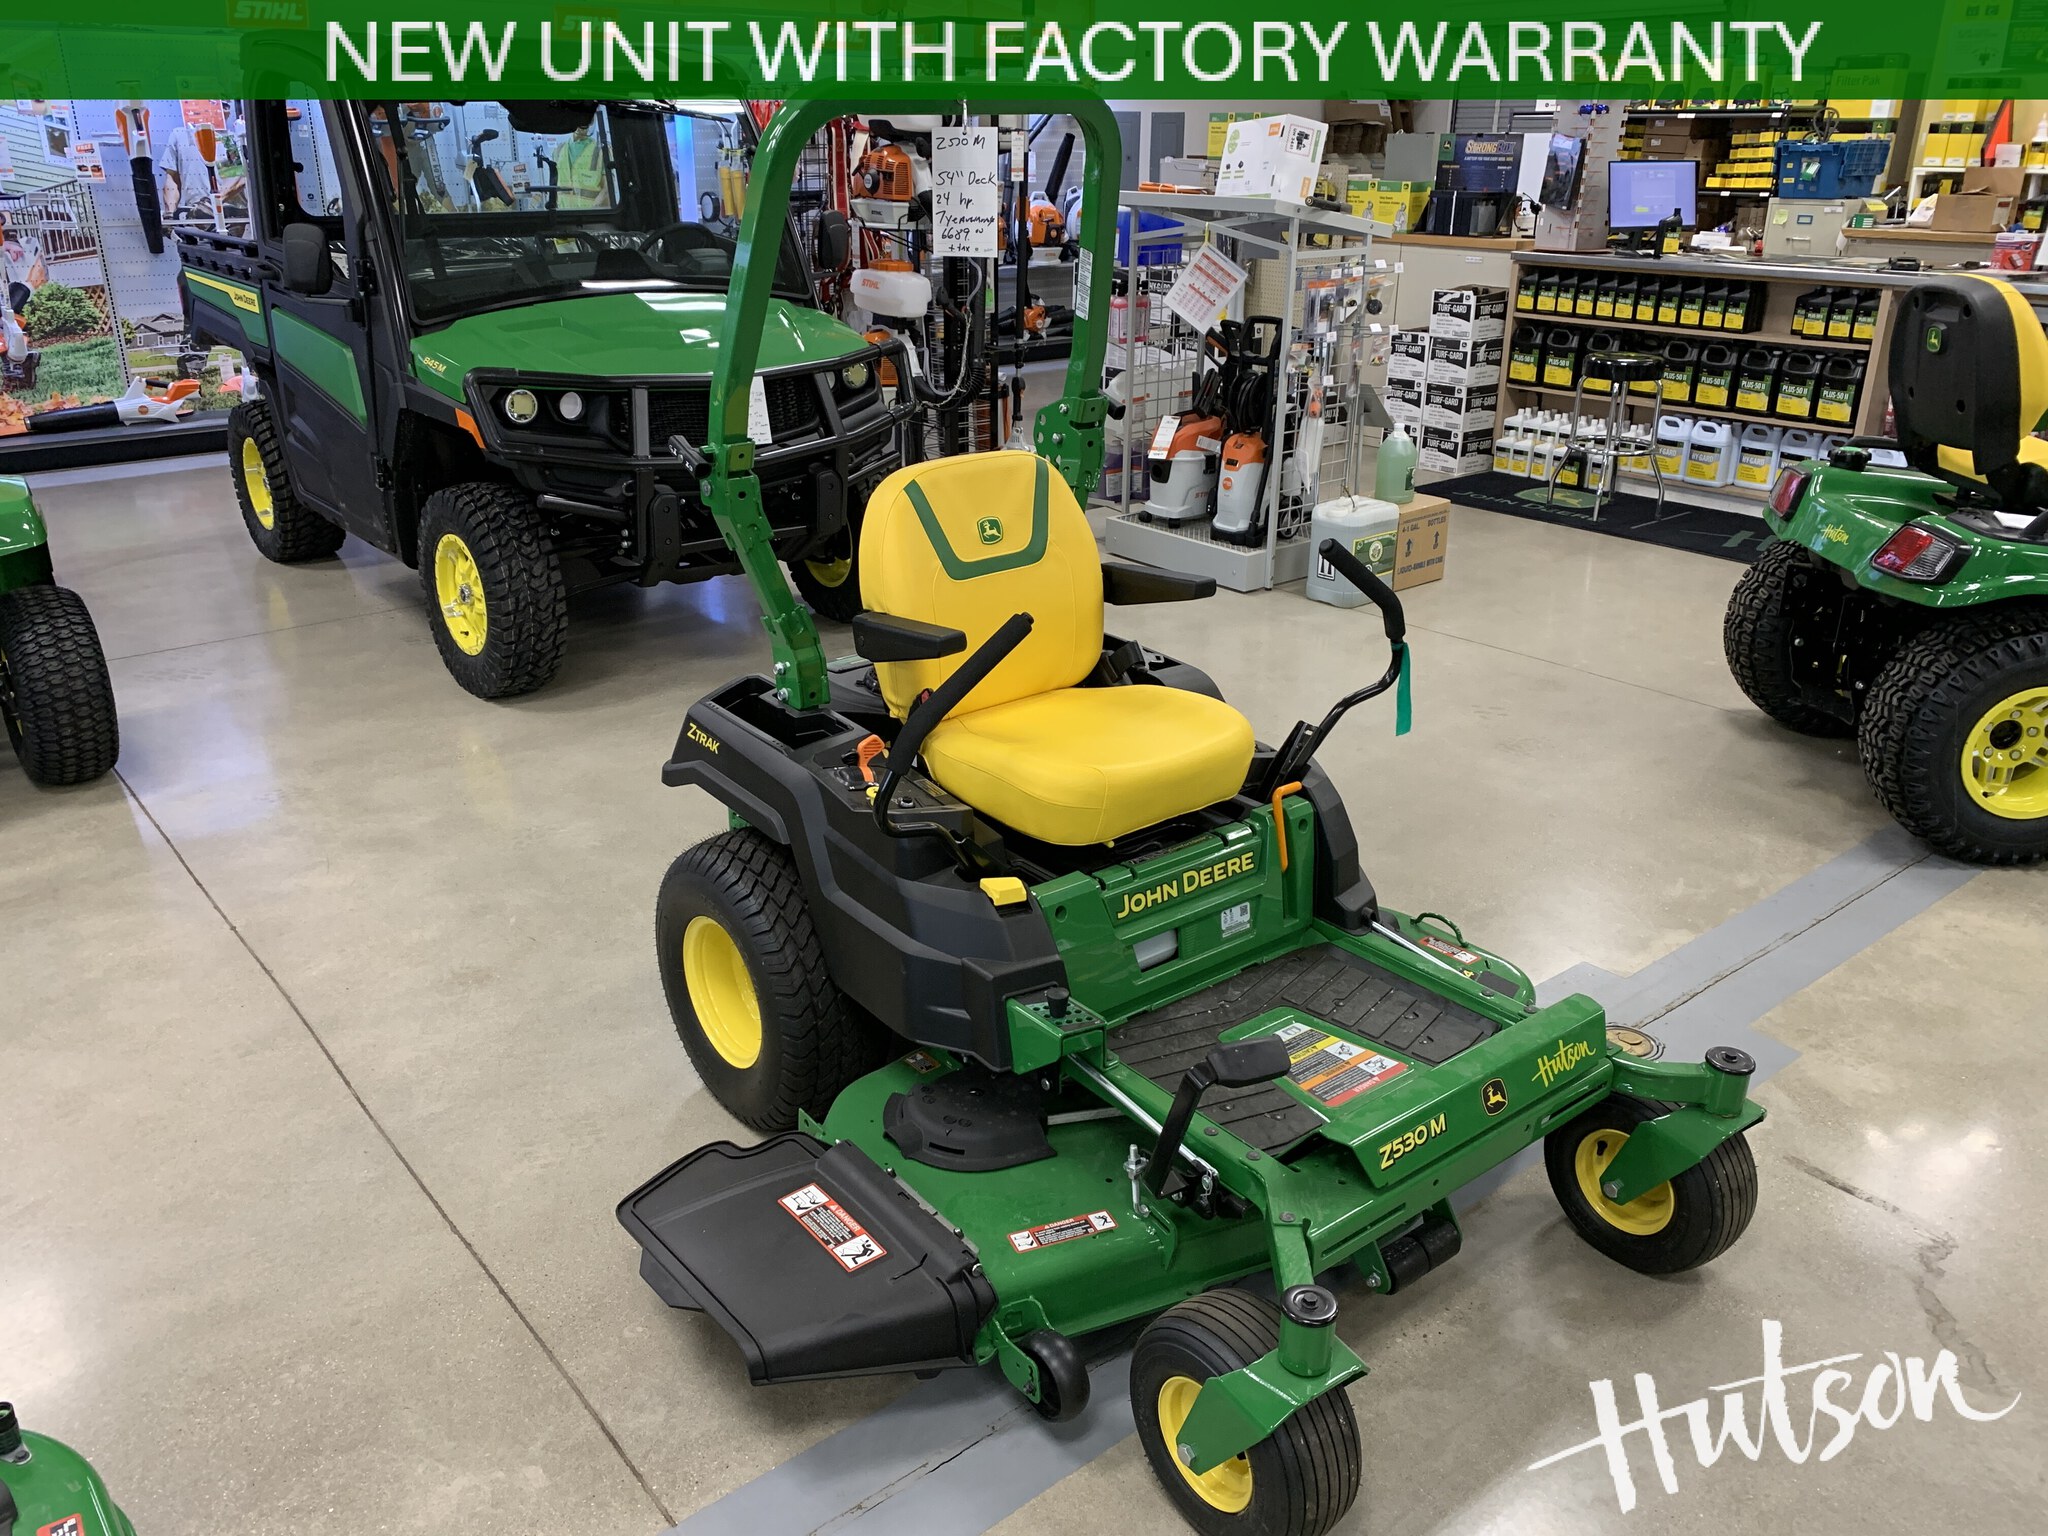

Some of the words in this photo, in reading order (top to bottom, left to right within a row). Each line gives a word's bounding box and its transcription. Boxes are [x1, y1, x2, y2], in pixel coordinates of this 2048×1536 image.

[968, 171, 997, 187] Deck
[935, 191, 950, 205] 24
[861, 278, 880, 290] STIHL
[1437, 303, 1467, 314] TURF-GARD
[1480, 303, 1505, 315] TURF-GARD
[1395, 344, 1422, 354] TURF-GARD
[1435, 349, 1463, 360] TURF-GARD
[423, 356, 447, 373] 845M
[1548, 358, 1565, 367] PLUS-50
[1663, 371, 1683, 380] PLUS-50
[1701, 376, 1720, 386] PLUS-50
[1741, 380, 1761, 389] PLUS-50
[1782, 384, 1803, 394] PLUS-50
[1822, 389, 1844, 400] PLUS-50
[1430, 395, 1459, 406] TURF-GARD
[1471, 396, 1497, 408] TURF-GARD
[1426, 439, 1455, 451] TURF-GARD
[1467, 439, 1492, 452] TURF-GARD
[1691, 452, 1714, 463] HY-GARD
[1742, 455, 1765, 466] HY-GARD
[687, 722, 720, 755] ZTRAK
[1117, 879, 1179, 920] JOHN
[1182, 851, 1255, 895] DEERE
[1531, 1039, 1597, 1088] Hutson
[1378, 1124, 1428, 1171] Z530
[1429, 1112, 1448, 1138] M
[835, 1208, 861, 1232] DANGER
[1049, 1218, 1075, 1228] DANGER
